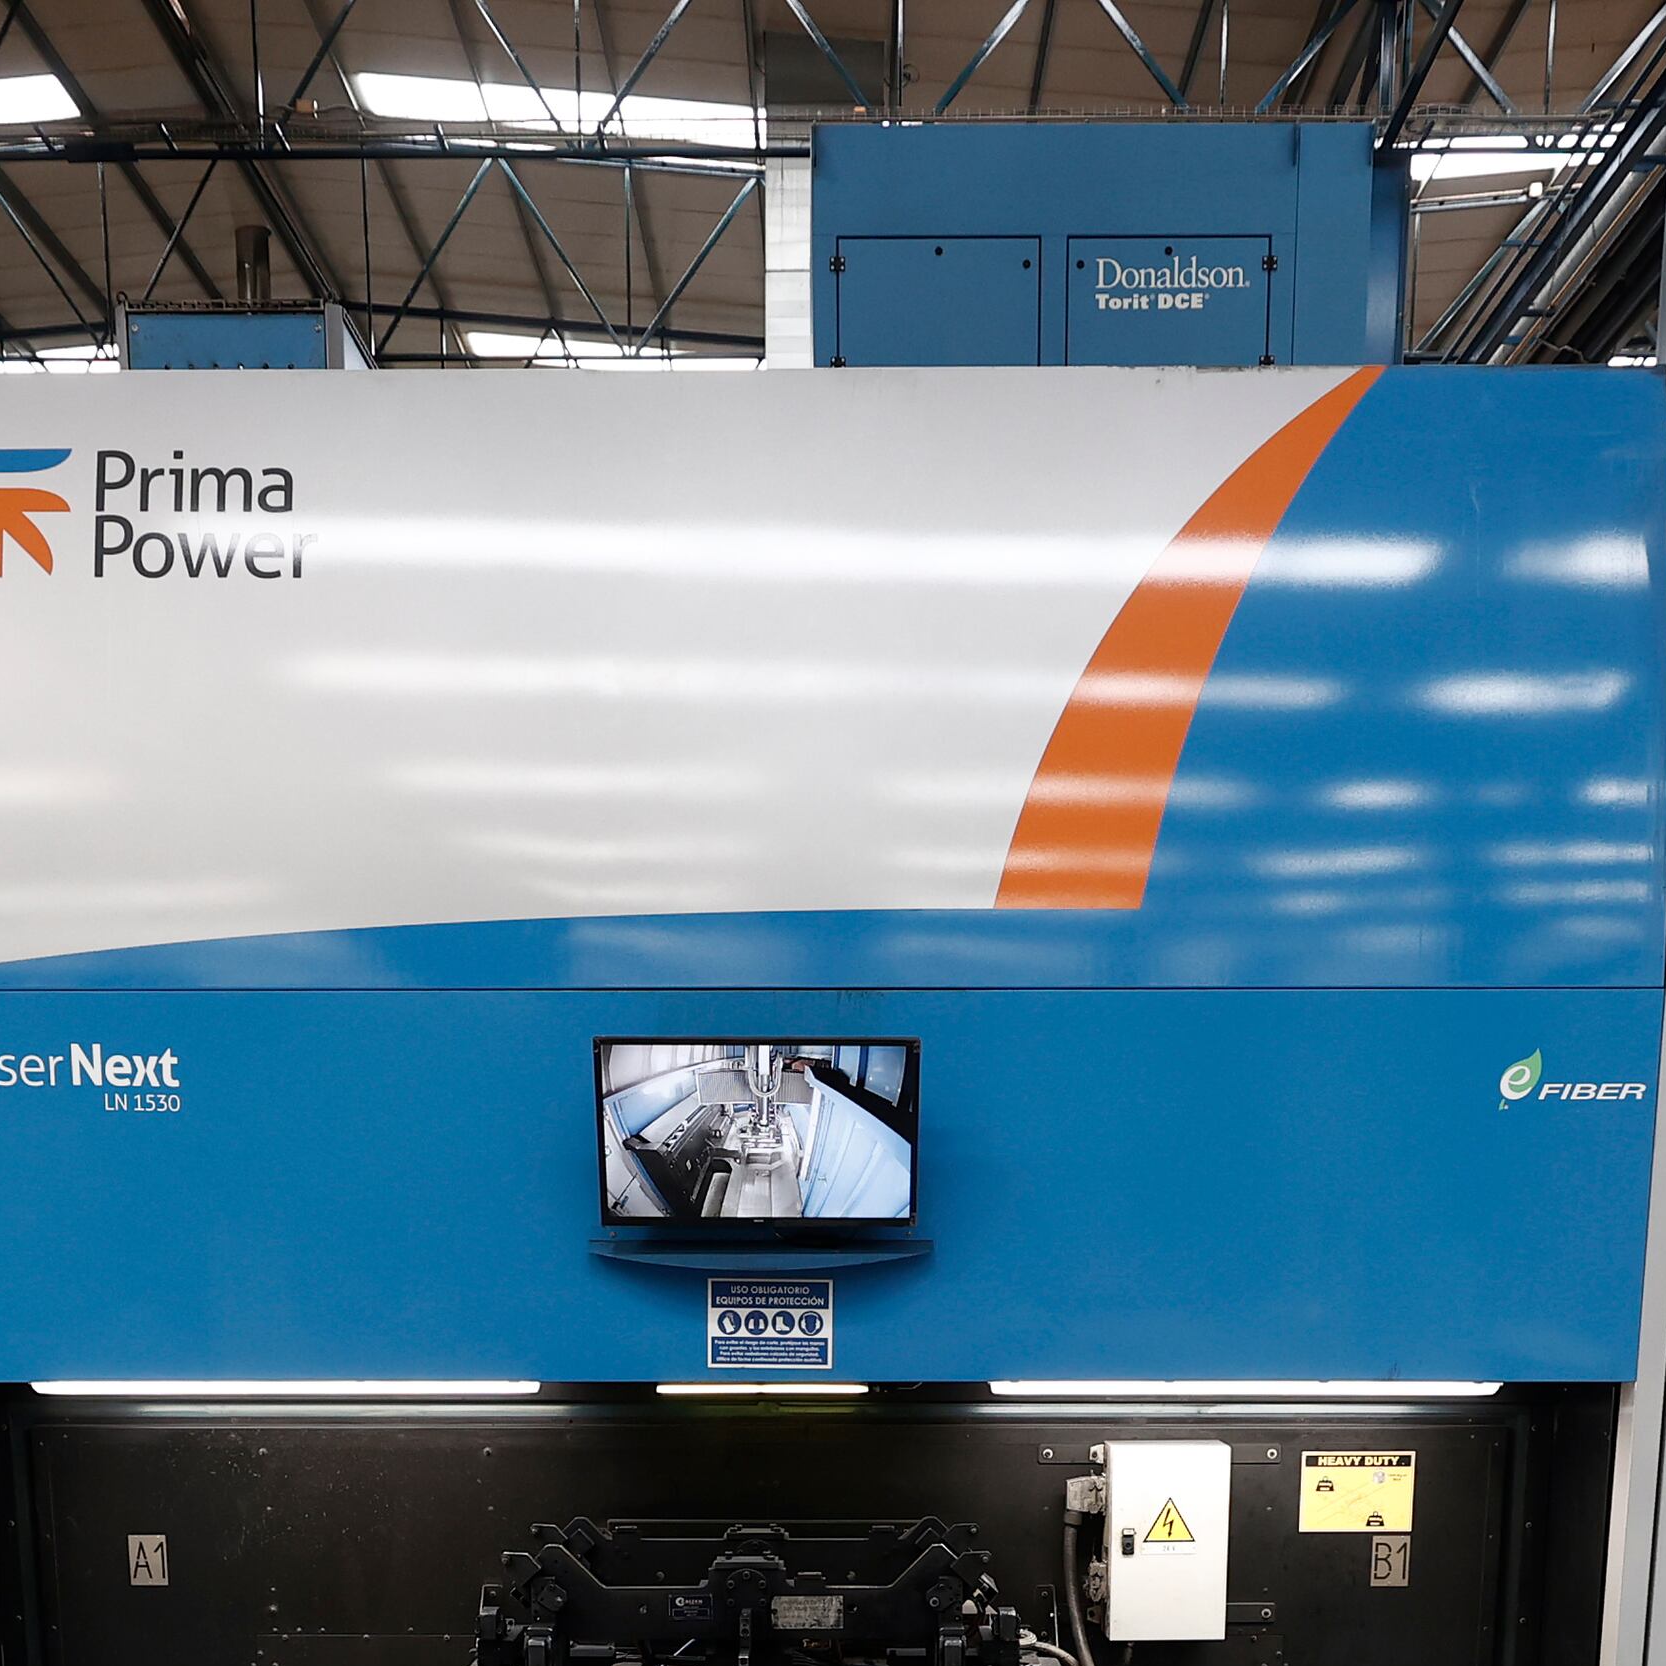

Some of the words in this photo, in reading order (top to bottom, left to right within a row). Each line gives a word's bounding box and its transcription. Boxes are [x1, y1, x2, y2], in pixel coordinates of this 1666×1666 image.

[1095, 256, 1247, 289] Donaldson
[1158, 293, 1204, 310] DCE
[95, 450, 294, 513] Prima
[94, 514, 319, 579] Power
[70, 1042, 181, 1088] Next
[104, 1093, 128, 1111] LN
[133, 1093, 181, 1112] 1530
[1538, 1083, 1647, 1101] FIBER
[716, 1296, 753, 1305] EQUIPOS
[755, 1297, 767, 1305] DE
[768, 1296, 824, 1306] PROTECCIÓN
[730, 1286, 749, 1294] USO
[751, 1286, 810, 1295] OBLIGATORIO
[1318, 1456, 1364, 1466] HEAVY
[1364, 1456, 1400, 1466] DUTY
[133, 1541, 166, 1579] A1
[1374, 1542, 1408, 1580] B1
